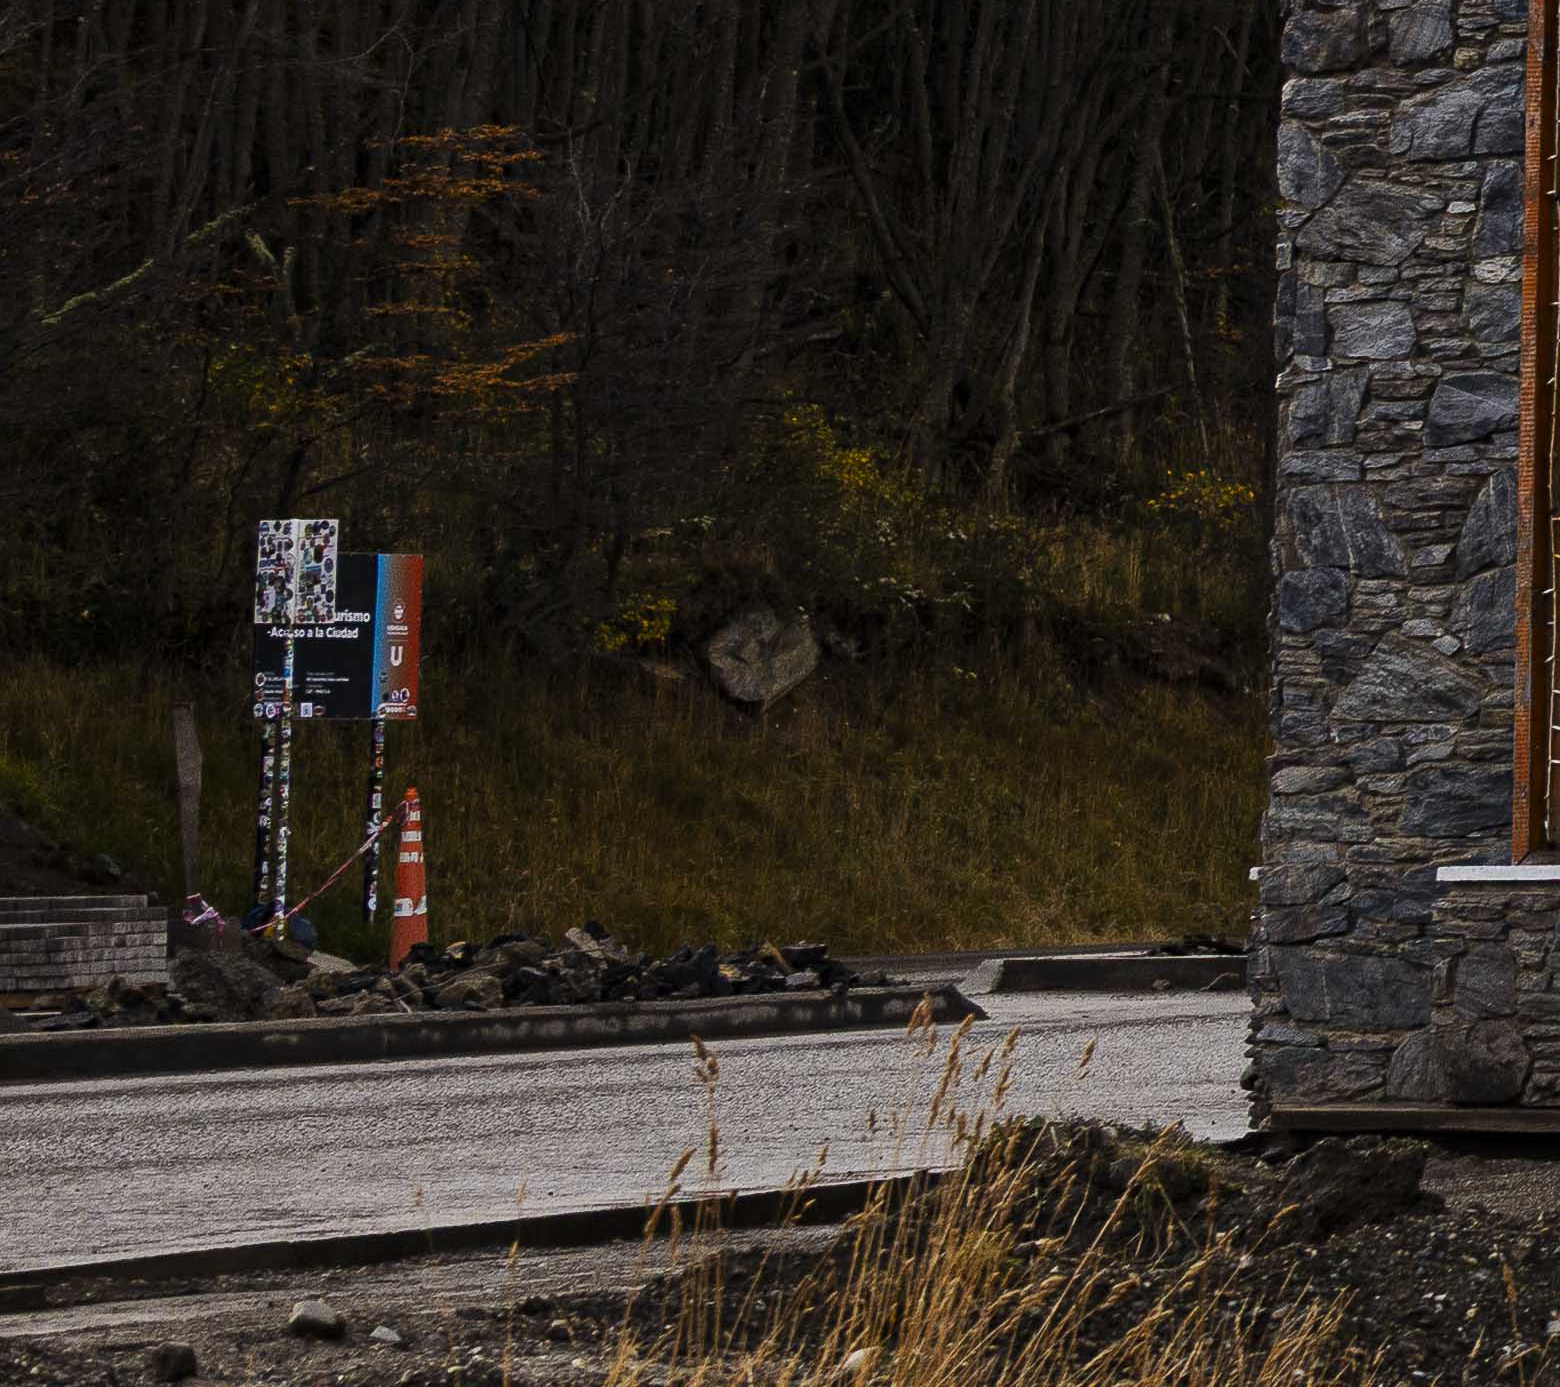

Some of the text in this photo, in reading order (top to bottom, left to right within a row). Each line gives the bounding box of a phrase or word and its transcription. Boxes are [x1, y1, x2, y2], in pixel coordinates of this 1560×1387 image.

[335, 609, 371, 622] urismo
[306, 629, 313, 638] a
[315, 626, 324, 638] la
[326, 626, 359, 638] Ciudad
[390, 645, 403, 667] U
